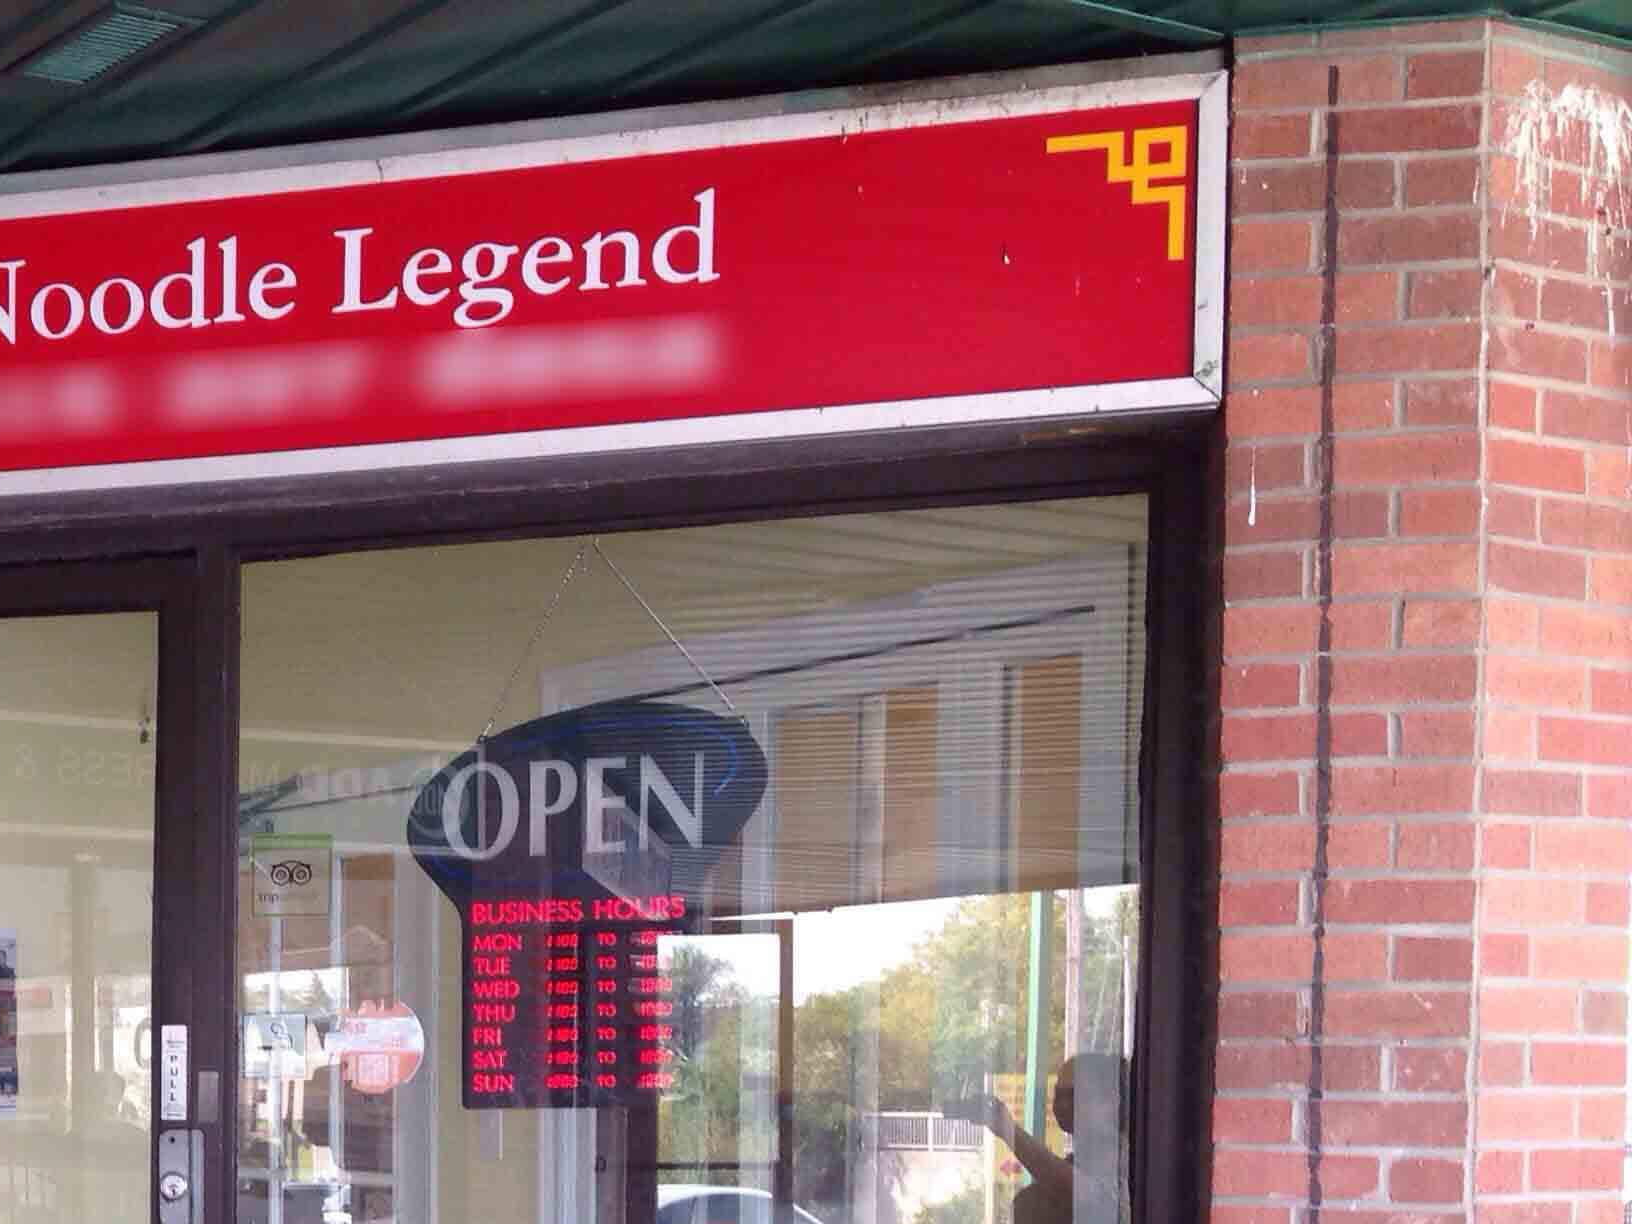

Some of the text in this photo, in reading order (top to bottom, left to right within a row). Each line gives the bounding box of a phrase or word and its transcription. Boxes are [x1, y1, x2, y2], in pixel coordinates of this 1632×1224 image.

[332, 187, 721, 328] Legend
[441, 751, 705, 861] OPEN
[471, 896, 686, 924] BUSINESS HOURS
[472, 932, 523, 952] MON
[596, 932, 617, 946] TO
[472, 955, 511, 976] TUE
[596, 956, 617, 969] TO
[472, 980, 520, 999] WED
[596, 979, 617, 993] TO
[472, 1003, 516, 1022] THU
[596, 1003, 617, 1017] TO
[472, 1026, 502, 1045] FRI
[596, 1026, 617, 1040] TO
[472, 1050, 508, 1069] SAT
[596, 1050, 617, 1064] TO
[472, 1073, 515, 1093] SUN
[596, 1074, 617, 1088] TO
